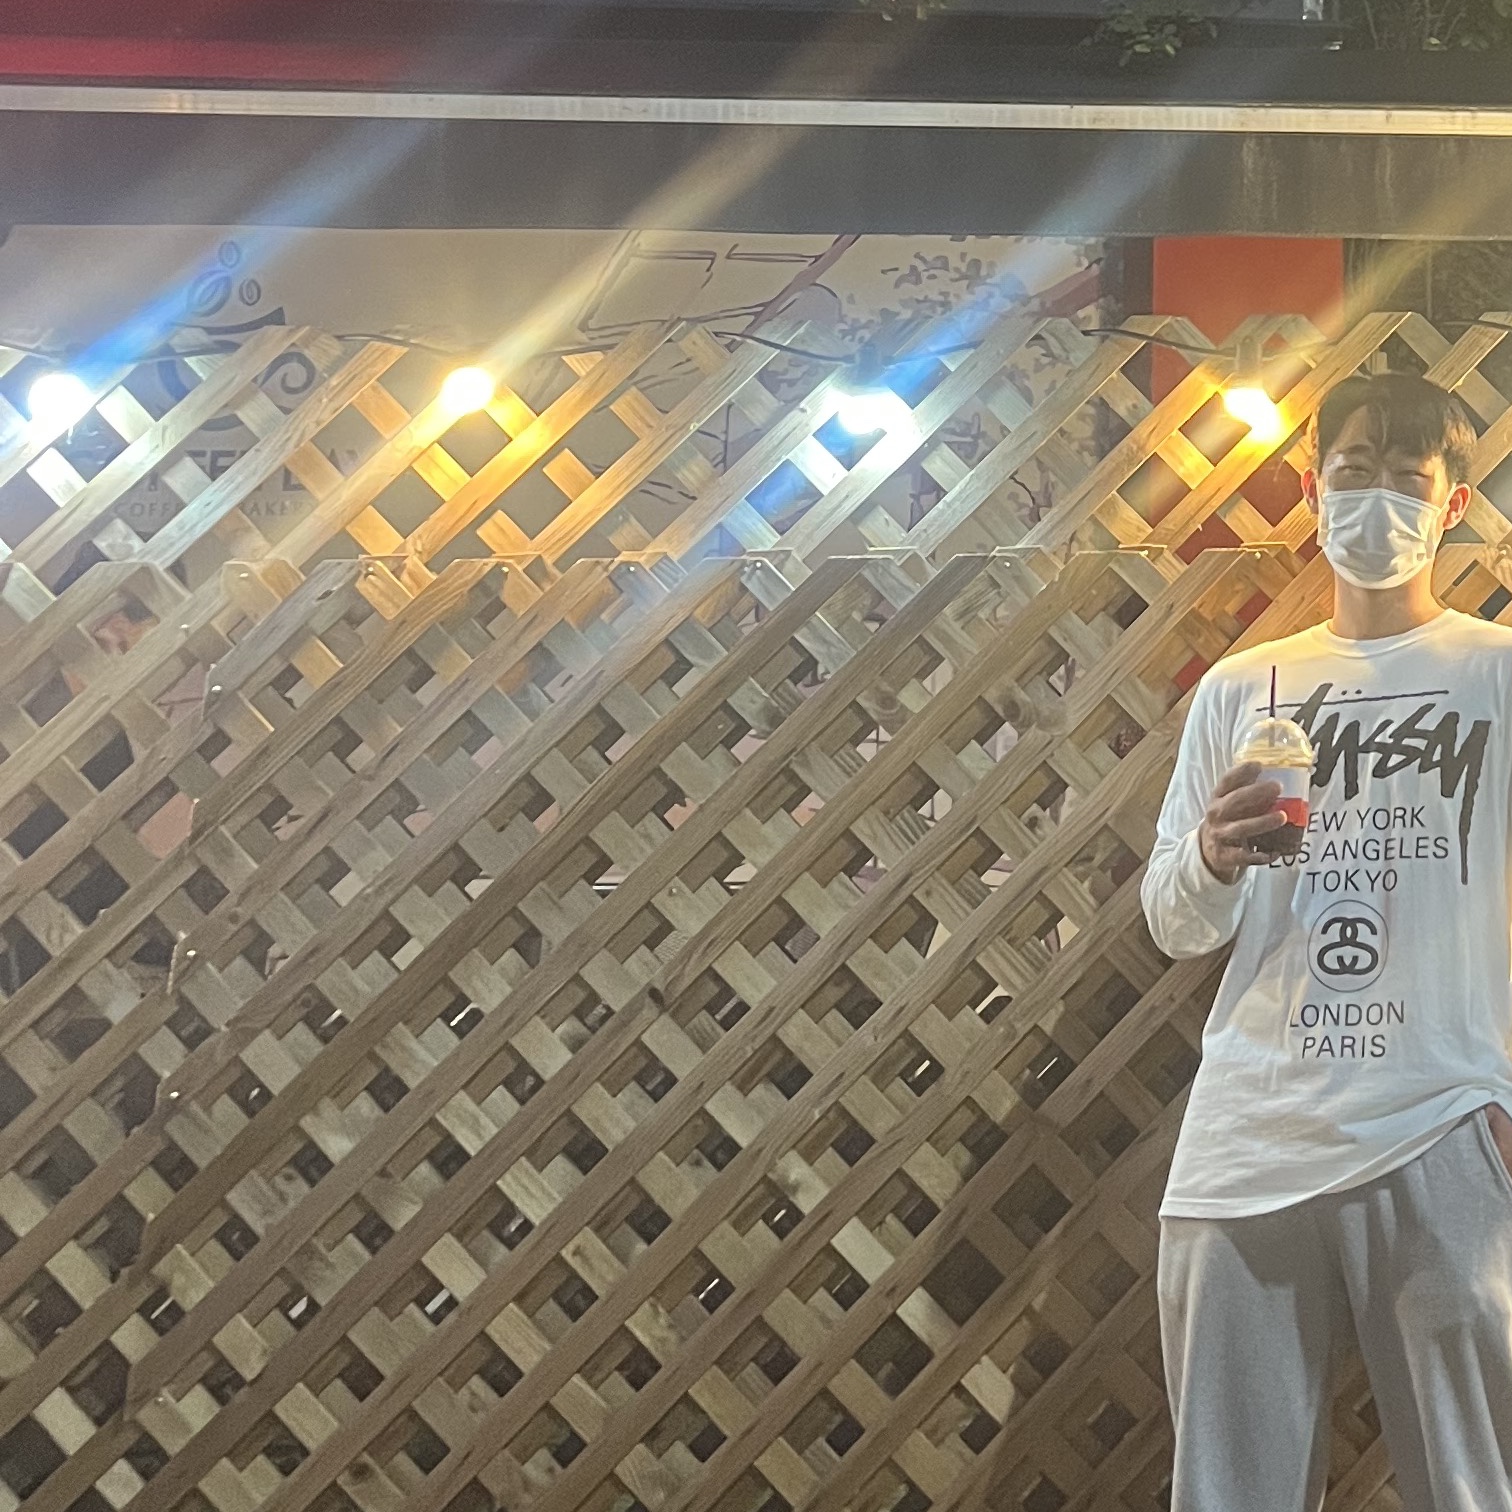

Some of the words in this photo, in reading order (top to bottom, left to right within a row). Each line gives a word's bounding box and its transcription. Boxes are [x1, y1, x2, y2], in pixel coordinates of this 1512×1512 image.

[1304, 810, 1348, 834] EW
[1356, 804, 1426, 831] YORK
[1320, 835, 1449, 863] ANGELES
[1306, 868, 1398, 894] TOKYO
[1289, 1000, 1405, 1029] LONDON
[1301, 1034, 1386, 1060] PARIS
